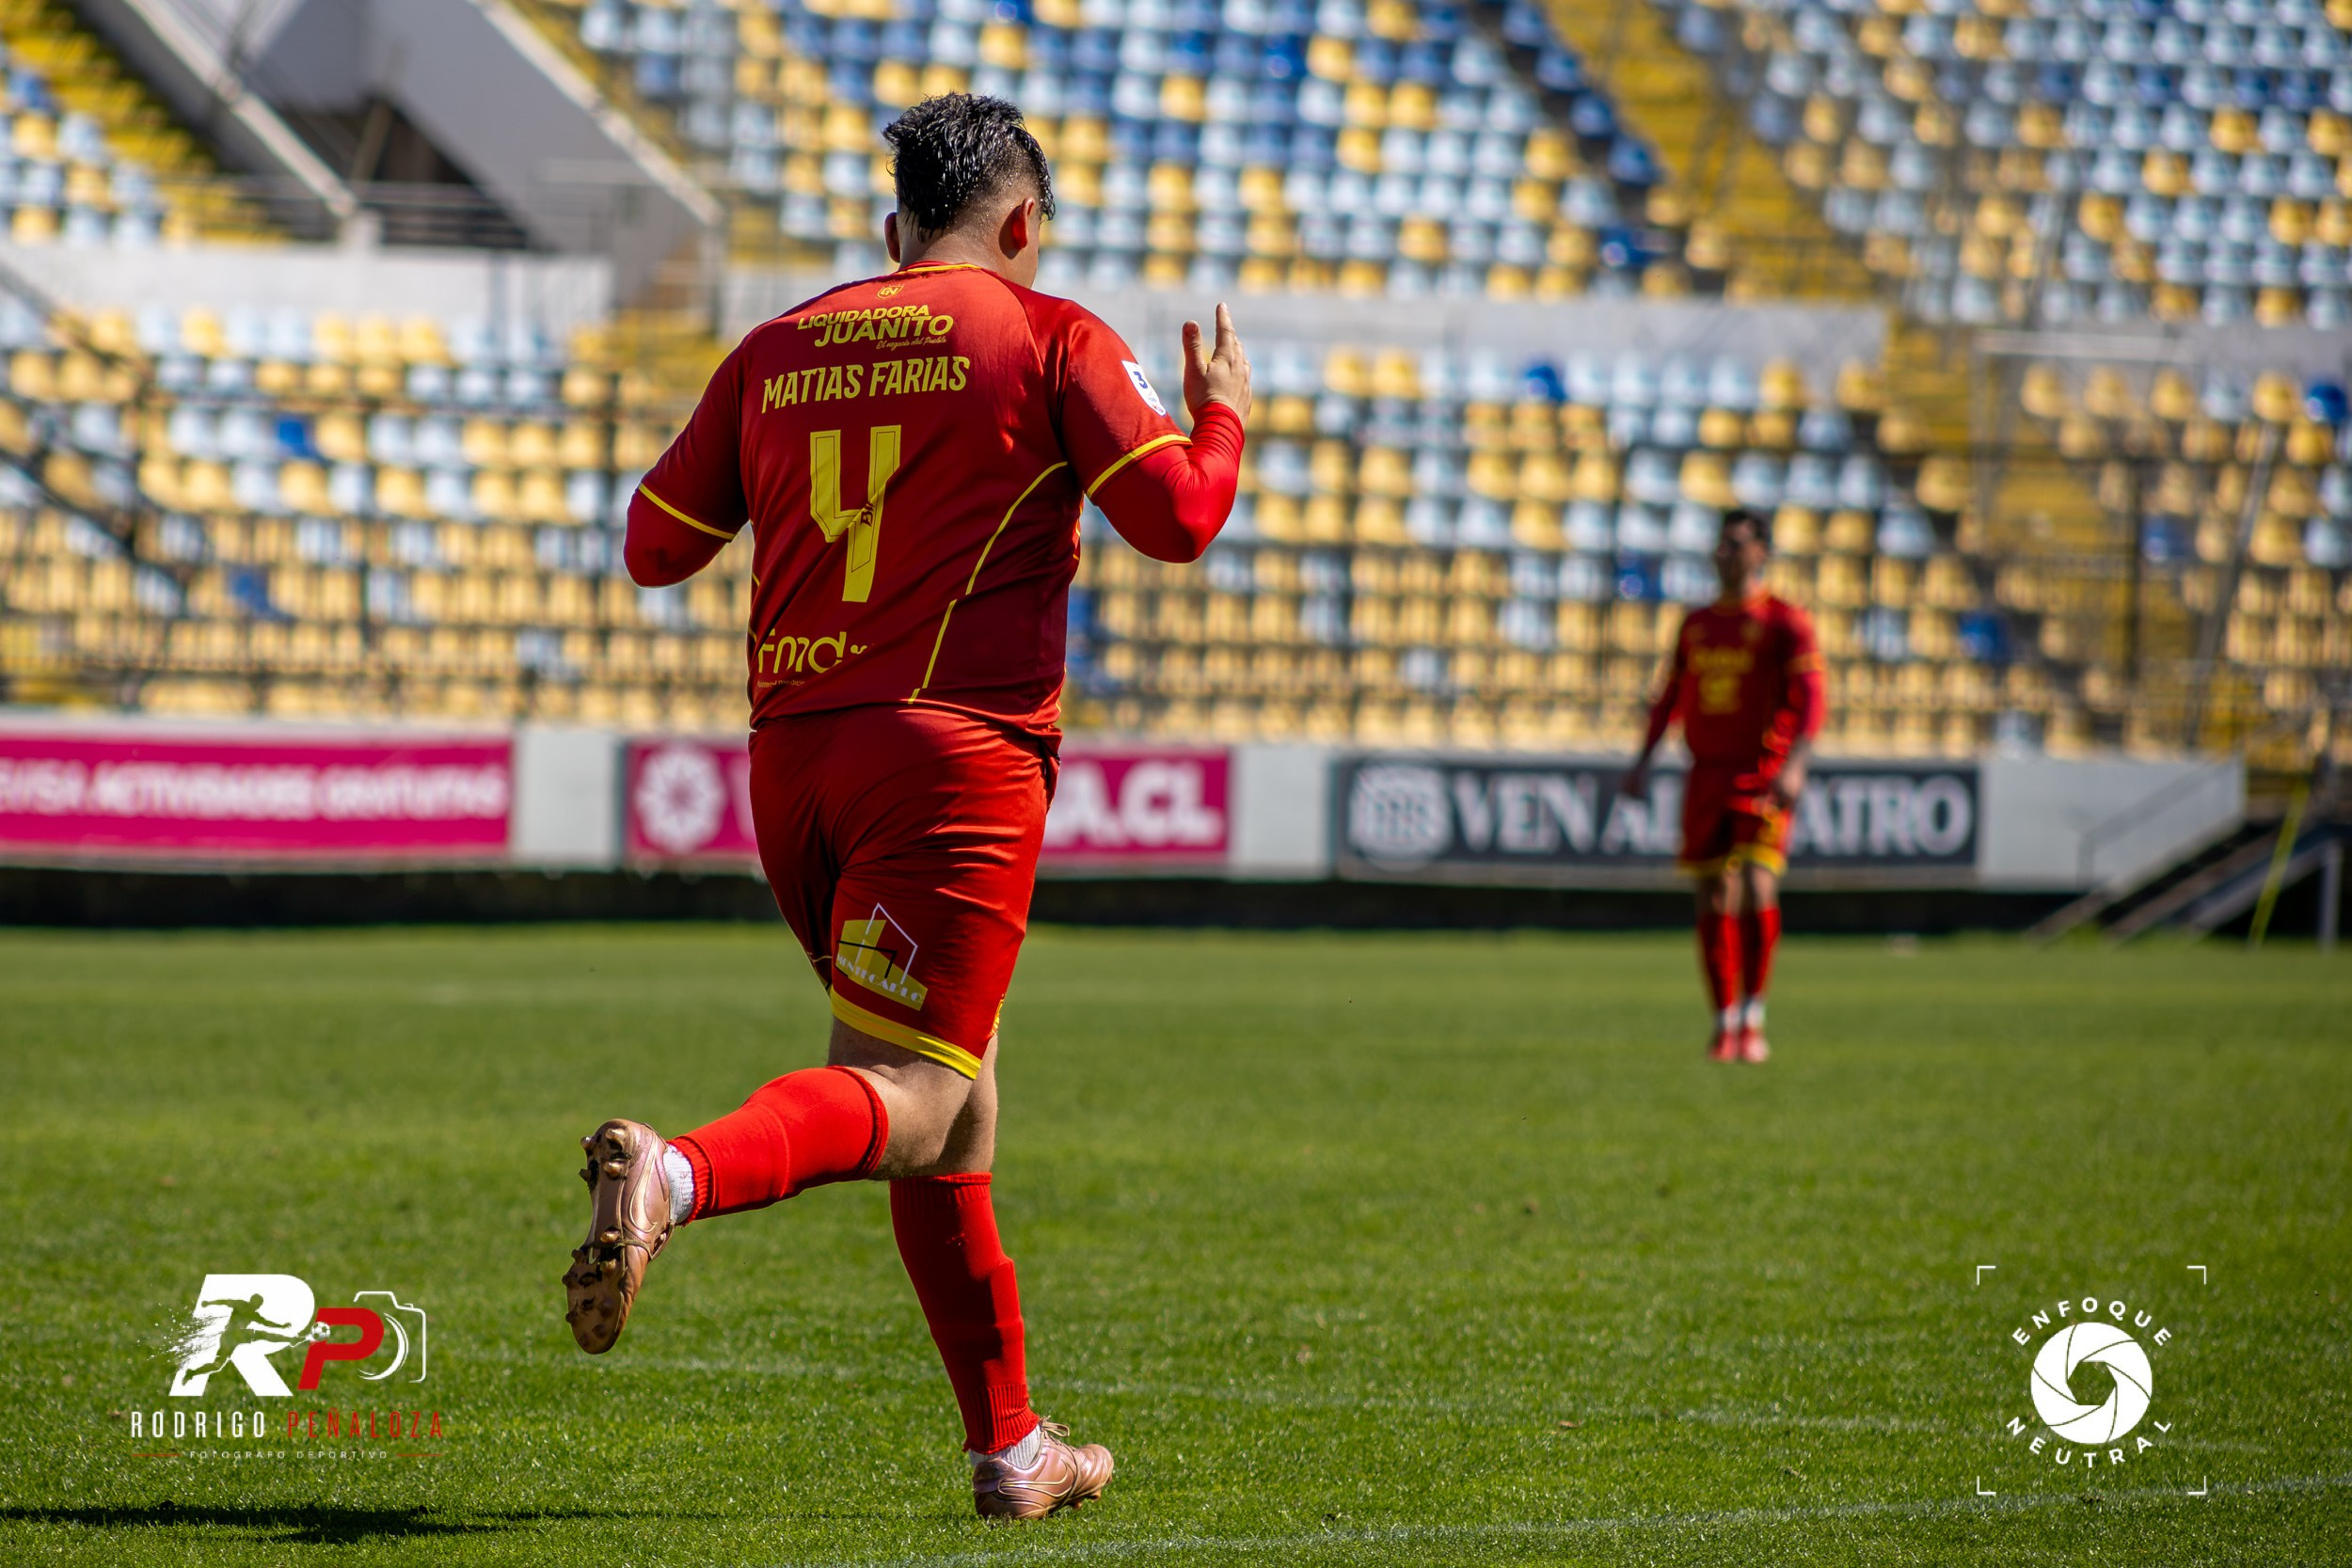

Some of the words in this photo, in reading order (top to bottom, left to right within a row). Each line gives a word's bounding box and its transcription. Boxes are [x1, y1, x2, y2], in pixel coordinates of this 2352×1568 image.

[798, 305, 930, 330] LIQUIDADORA
[814, 315, 954, 347] JUANITO
[761, 364, 865, 414] MATIAS
[868, 356, 971, 397] FARIAS
[1133, 371, 1149, 389] 3
[810, 424, 901, 603] 4
[1451, 771, 1600, 853] VEN
